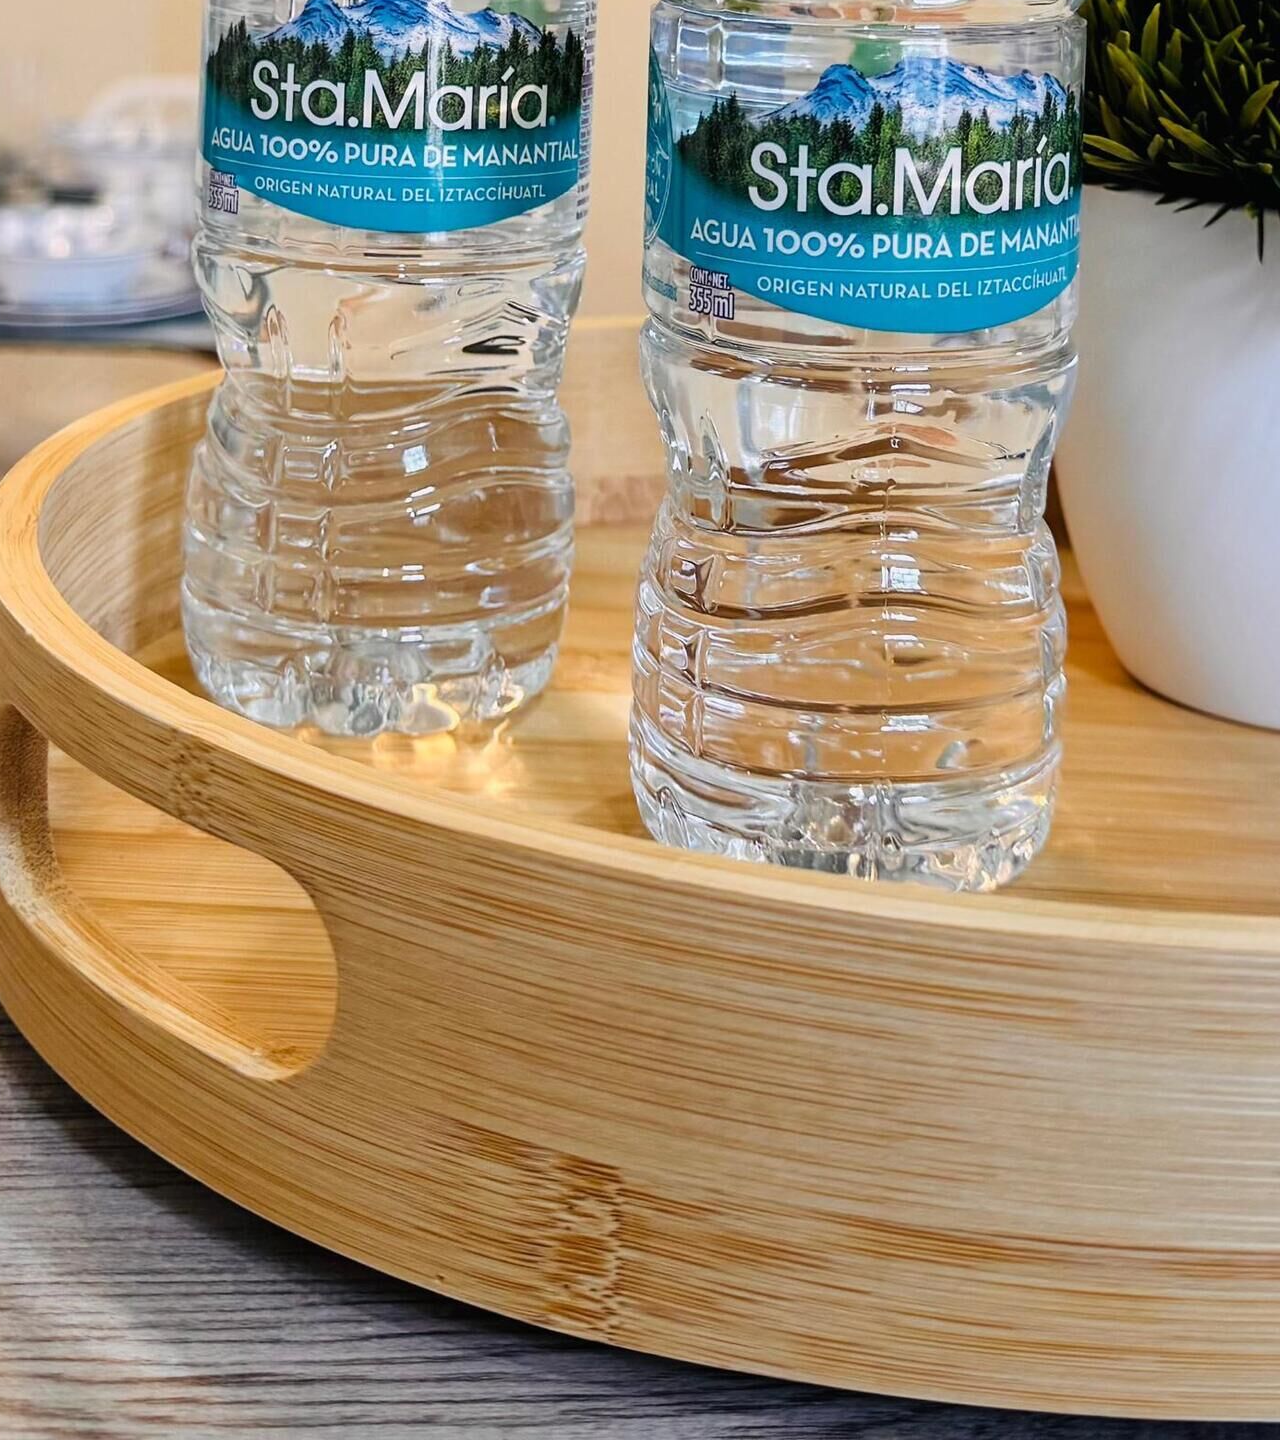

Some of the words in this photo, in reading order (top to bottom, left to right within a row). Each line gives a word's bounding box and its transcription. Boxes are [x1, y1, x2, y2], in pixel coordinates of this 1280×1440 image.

[250, 59, 549, 132] Sta.María
[211, 126, 256, 154] AGUA
[259, 134, 339, 164] 100%
[344, 142, 417, 168] PURA
[423, 144, 458, 169] DE
[463, 138, 579, 168] MANANTIAL
[254, 175, 314, 196] ORIGEN
[317, 184, 397, 202] NATURAL
[402, 187, 435, 202] DEL
[440, 181, 547, 203] IZTACCÍHUATL
[748, 134, 1071, 216] Sta.María
[690, 216, 757, 251] AGUA
[762, 227, 866, 259] 100%
[872, 233, 953, 259] PURA
[960, 230, 996, 258] DE
[688, 285, 713, 315] 355
[713, 292, 735, 320] ml
[756, 276, 834, 297] ORIGEN
[839, 282, 932, 300] NATURAL
[937, 281, 972, 299] DEL
[977, 266, 1068, 297] IZTACCÍHUATL
